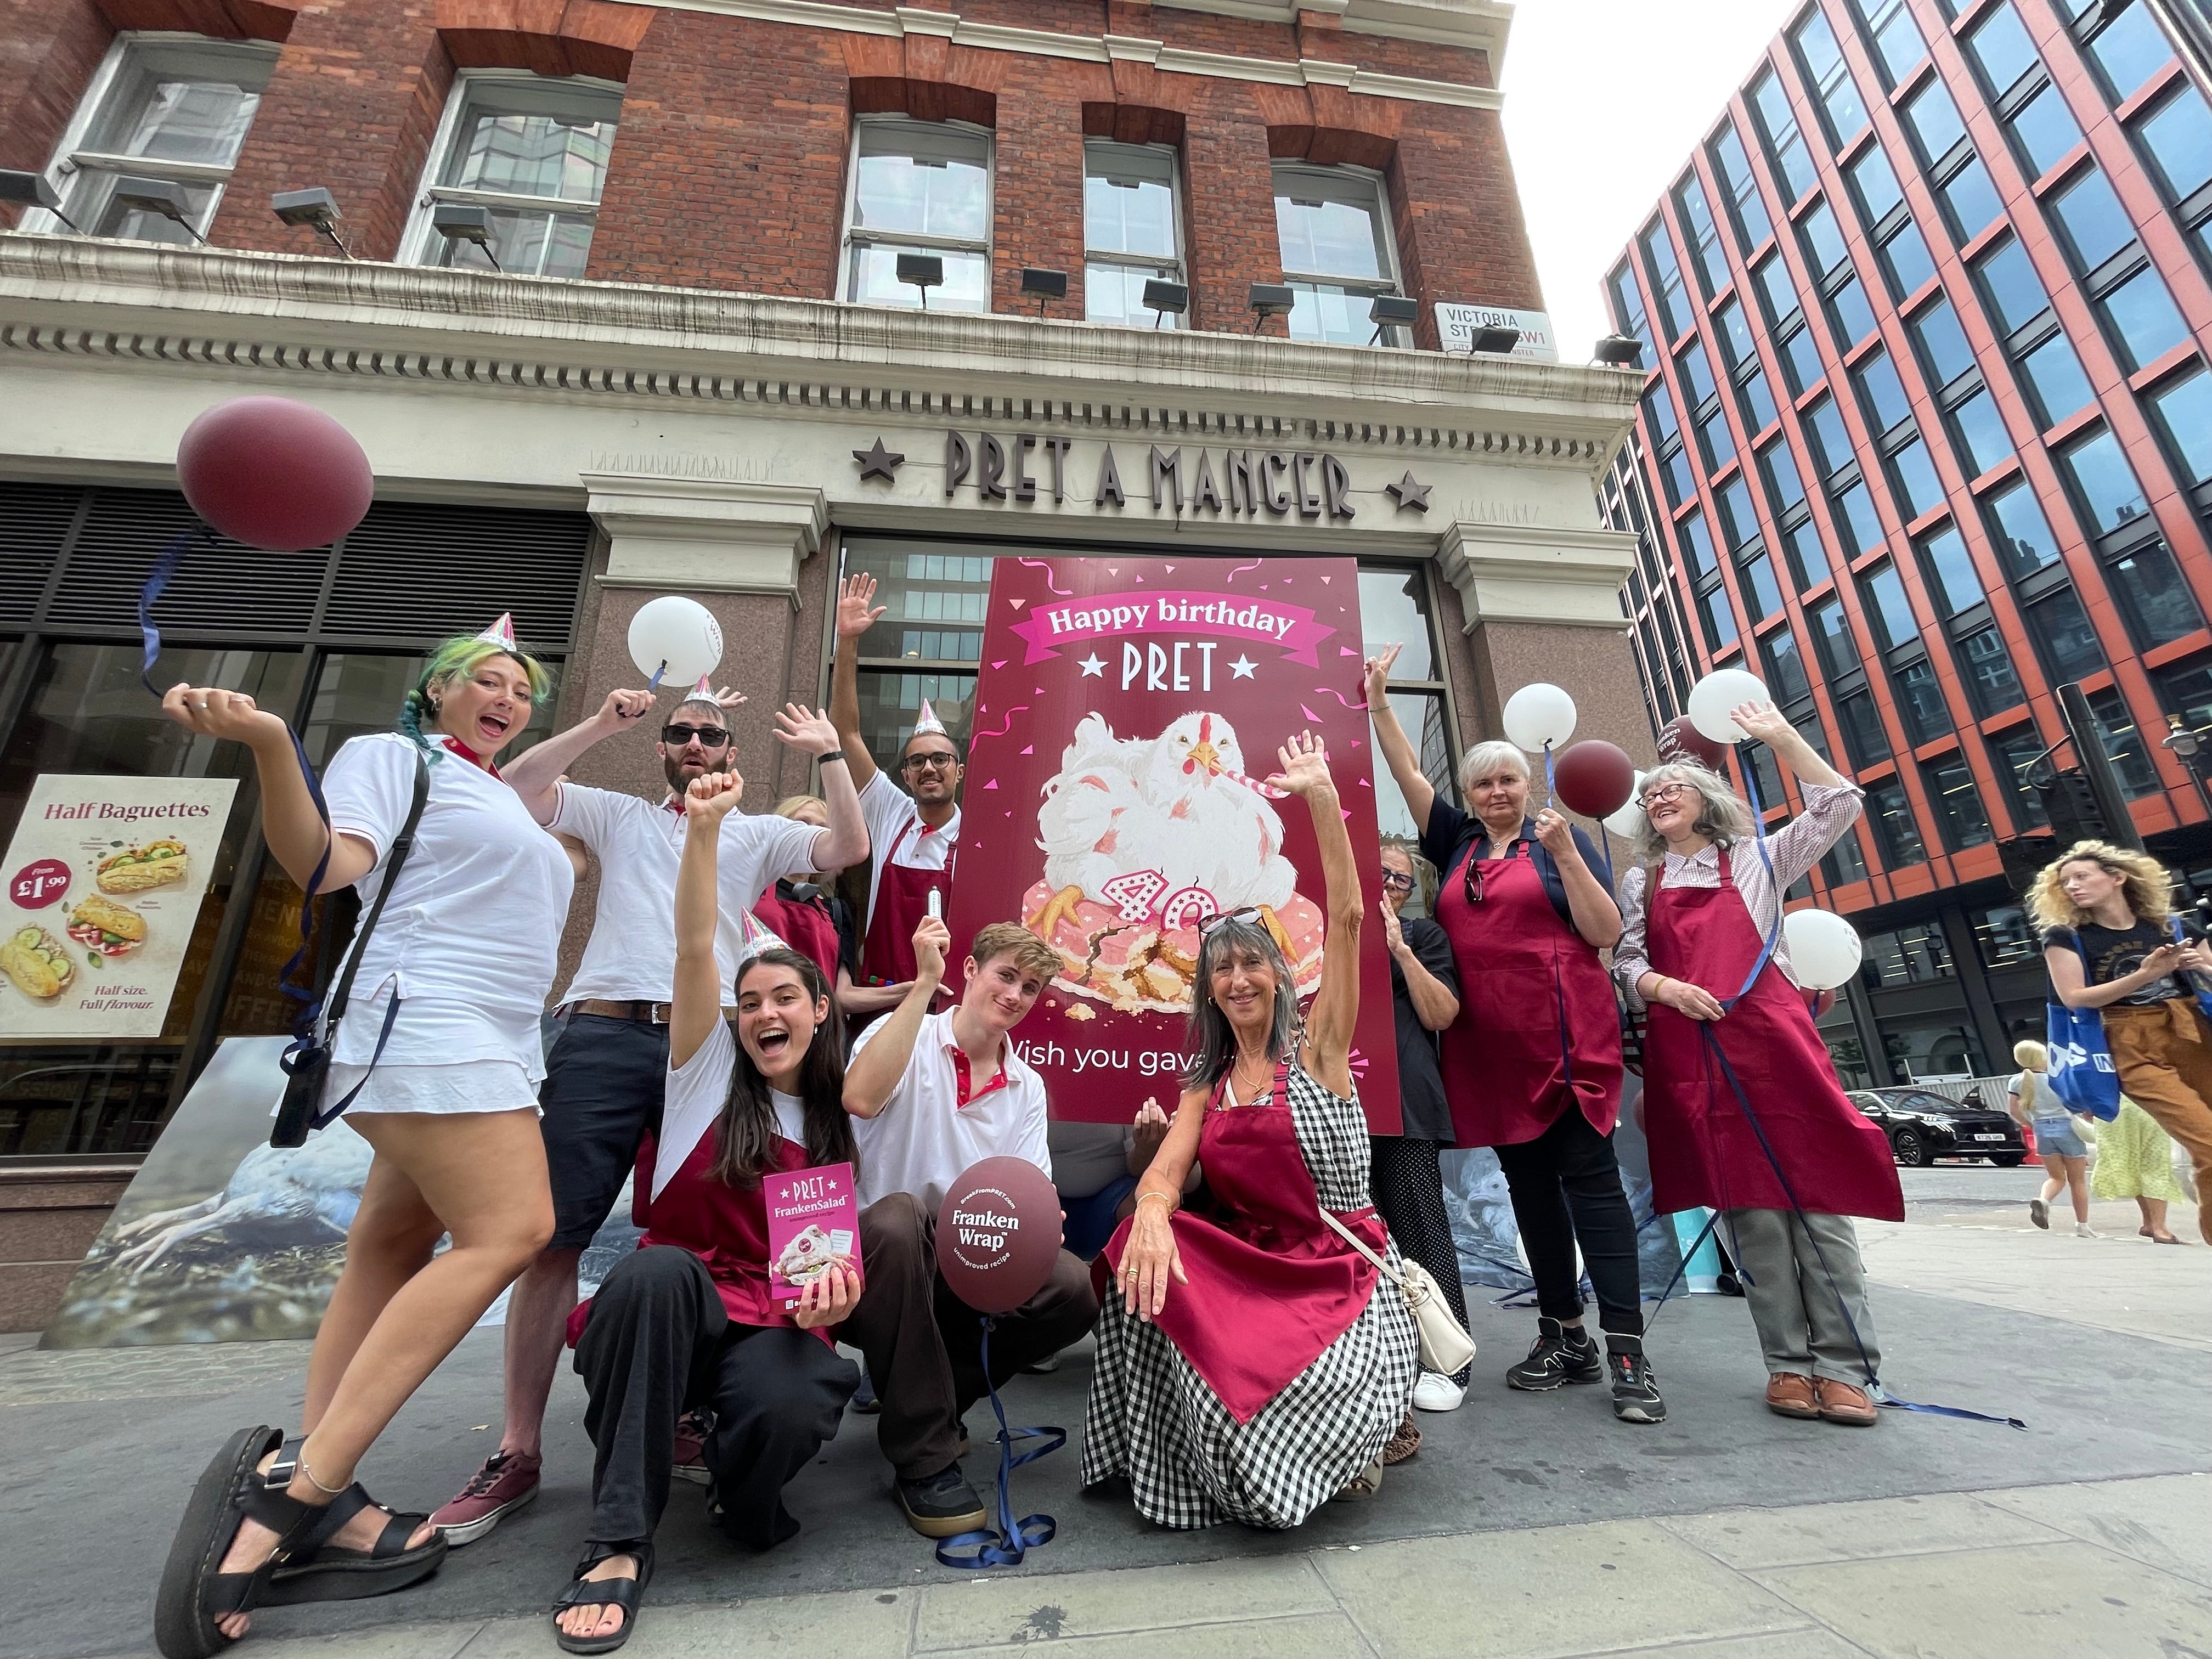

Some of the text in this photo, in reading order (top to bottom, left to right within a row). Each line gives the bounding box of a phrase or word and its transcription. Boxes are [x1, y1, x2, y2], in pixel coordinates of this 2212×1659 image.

[1447, 308, 1519, 328] VICTORIA
[945, 428, 1356, 521] PRET A MANGER
[1047, 597, 1297, 641] Happy birthday
[1121, 641, 1218, 692] PRET
[44, 802, 211, 823] Half Baguettes
[31, 866, 55, 876] From
[16, 876, 67, 899] £1.99
[94, 985, 148, 996] Half size.
[80, 999, 154, 1012] Full flavour.
[1013, 1039, 1065, 1066] ish
[1072, 1047, 1130, 1073] you
[793, 1176, 824, 1202] PRET
[960, 1187, 1016, 1210] BreakFromPRET.com
[951, 1209, 1019, 1231] Franken
[953, 1247, 1011, 1270] unimproved recipe
